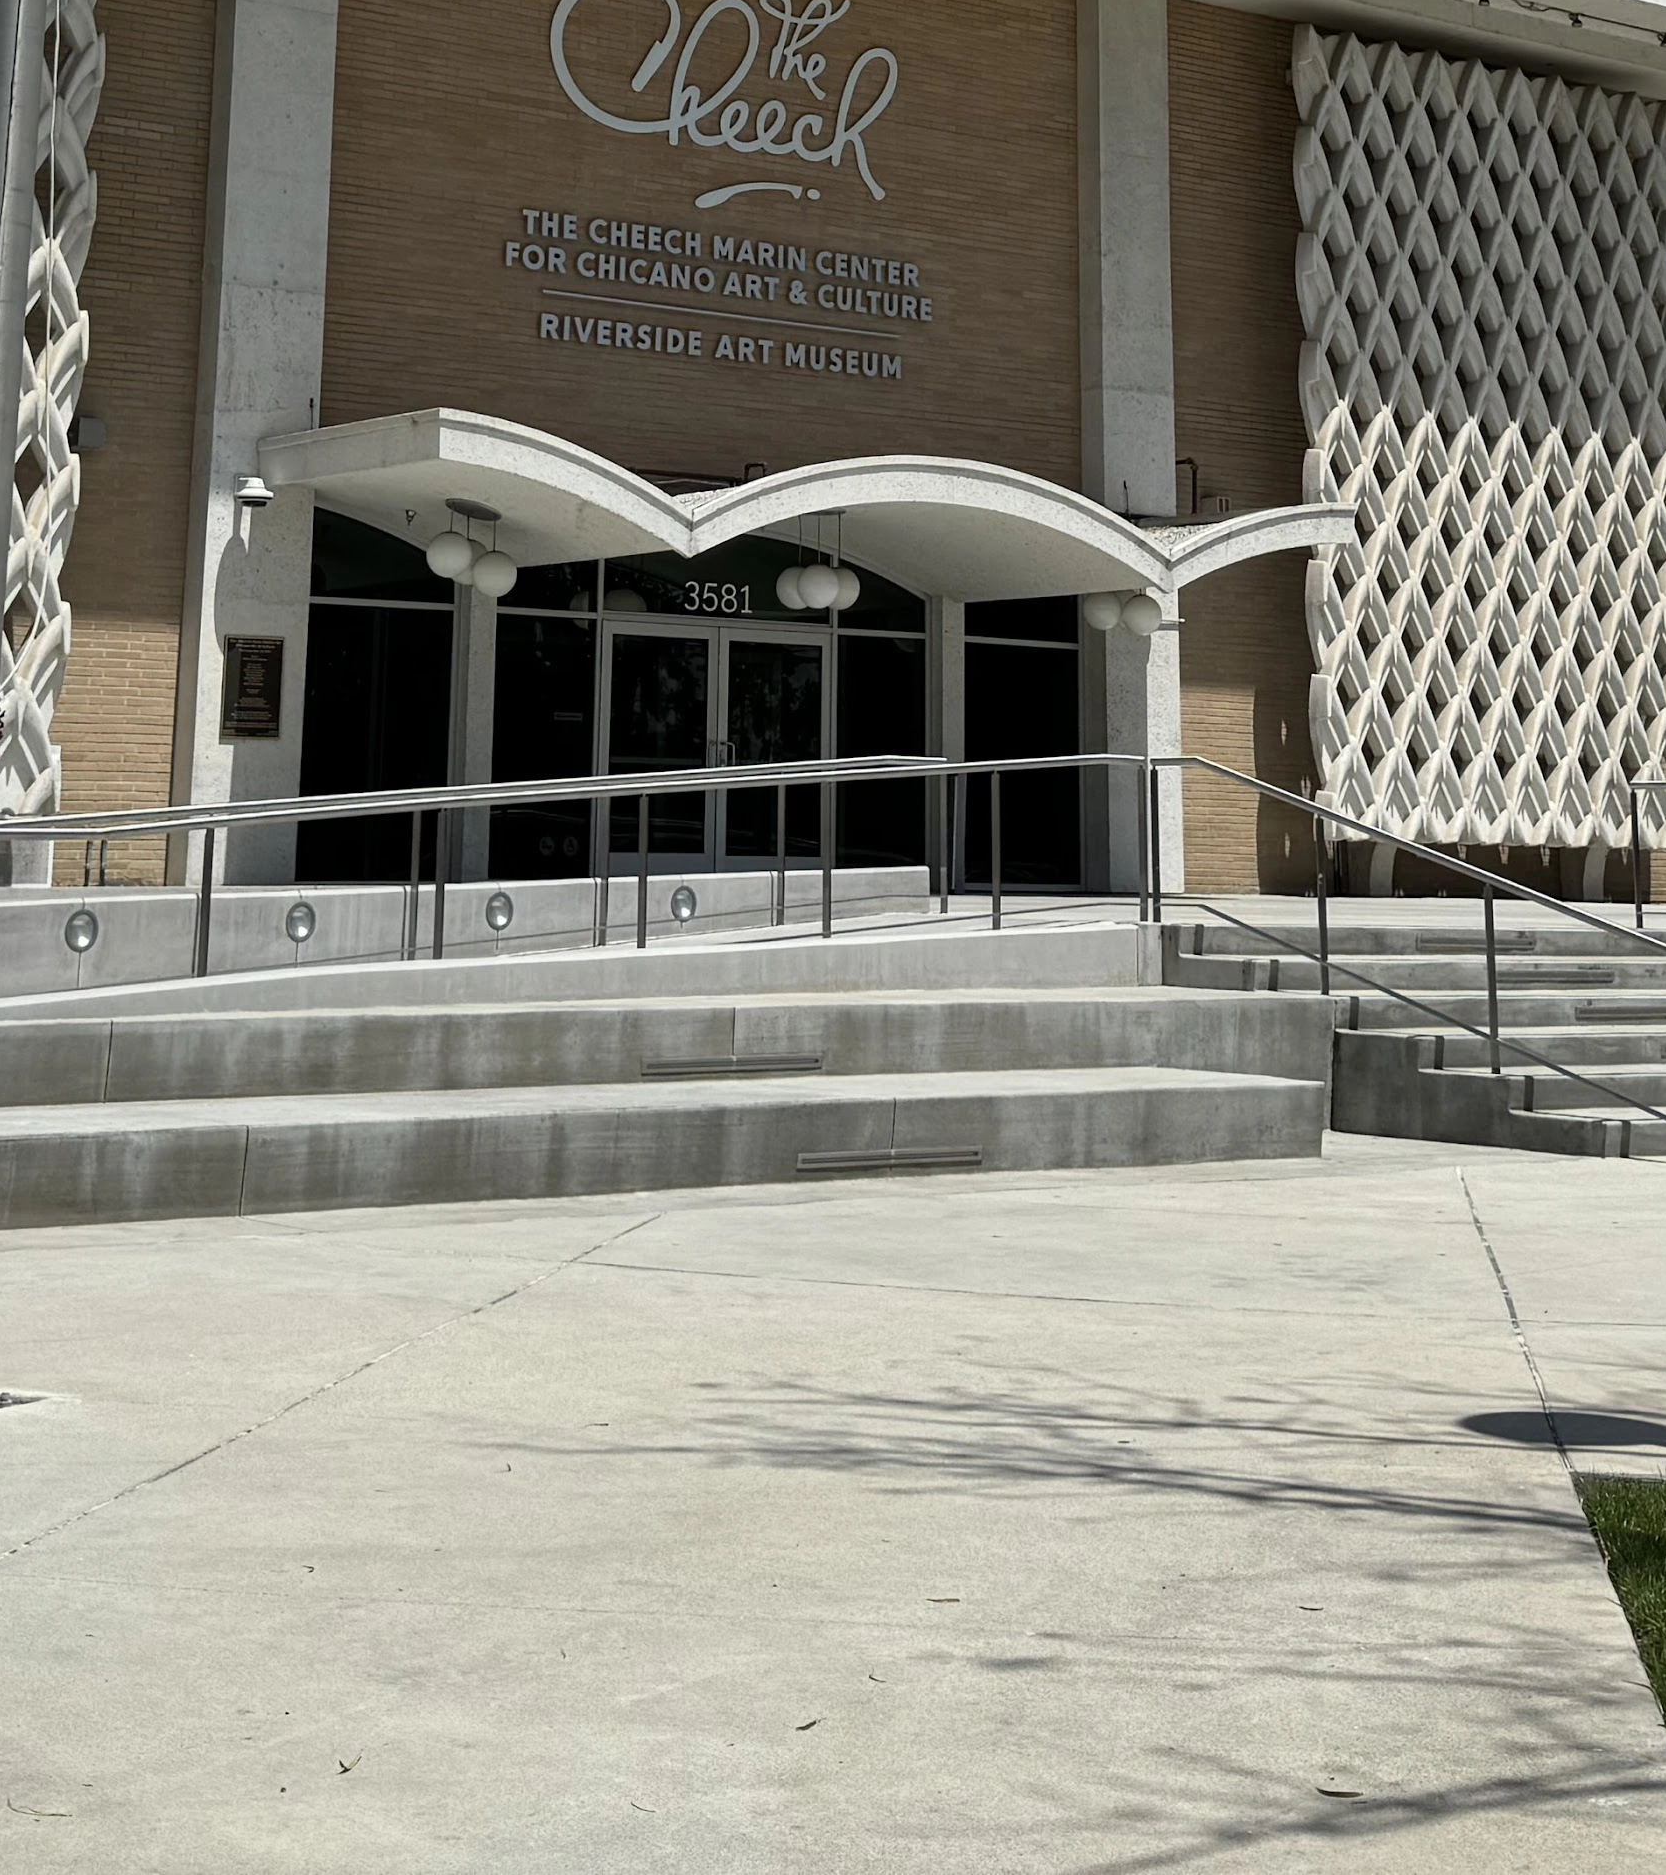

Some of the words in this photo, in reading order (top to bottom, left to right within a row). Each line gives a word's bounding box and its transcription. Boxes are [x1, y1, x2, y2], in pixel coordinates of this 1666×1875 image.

[505, 240, 567, 274] FOR
[576, 252, 716, 293] CHICANO
[722, 271, 780, 301] ART
[788, 279, 808, 305] &
[817, 283, 933, 322] CULTURE
[522, 208, 578, 240] THE
[588, 218, 702, 257] CHEECH
[713, 235, 806, 271] MARIN
[815, 251, 920, 288] CENTER
[540, 312, 702, 356] RIVERSIDE
[714, 334, 774, 365] ART
[785, 342, 902, 379] MUSEUM
[684, 580, 753, 614] 3581
